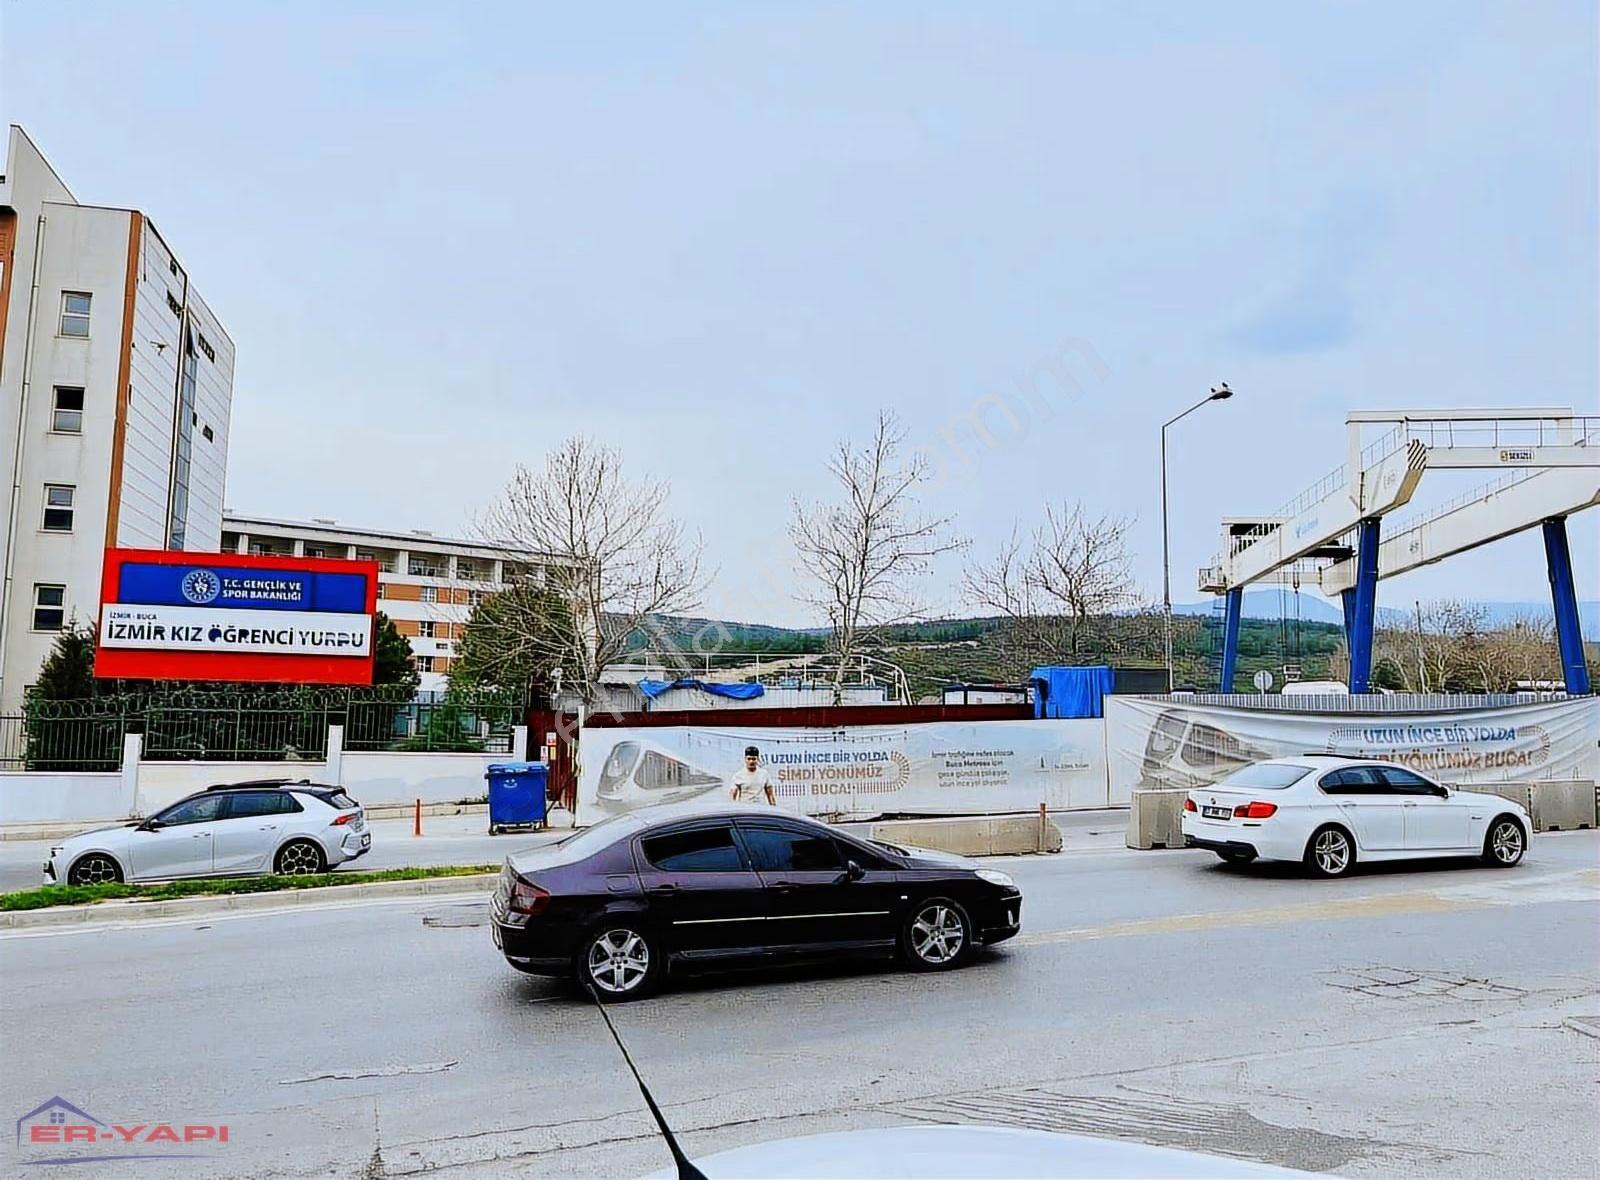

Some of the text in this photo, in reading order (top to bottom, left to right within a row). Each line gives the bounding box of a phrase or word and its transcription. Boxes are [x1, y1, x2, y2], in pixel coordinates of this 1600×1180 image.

[223, 579, 302, 591] T.C. GENÇLİK VE
[222, 589, 302, 601] SPOR BAKANLIĞI
[108, 620, 166, 641] İZMİR
[171, 625, 203, 642] KIZ
[208, 624, 294, 645] ÖĞRENCİ
[1363, 723, 1516, 744] UZUN İNCE BİR YOLDA
[771, 750, 889, 764] UZUN İNCE BİR YOLDA
[778, 764, 883, 783] ŞİMDİ YÖNÜMÜZ
